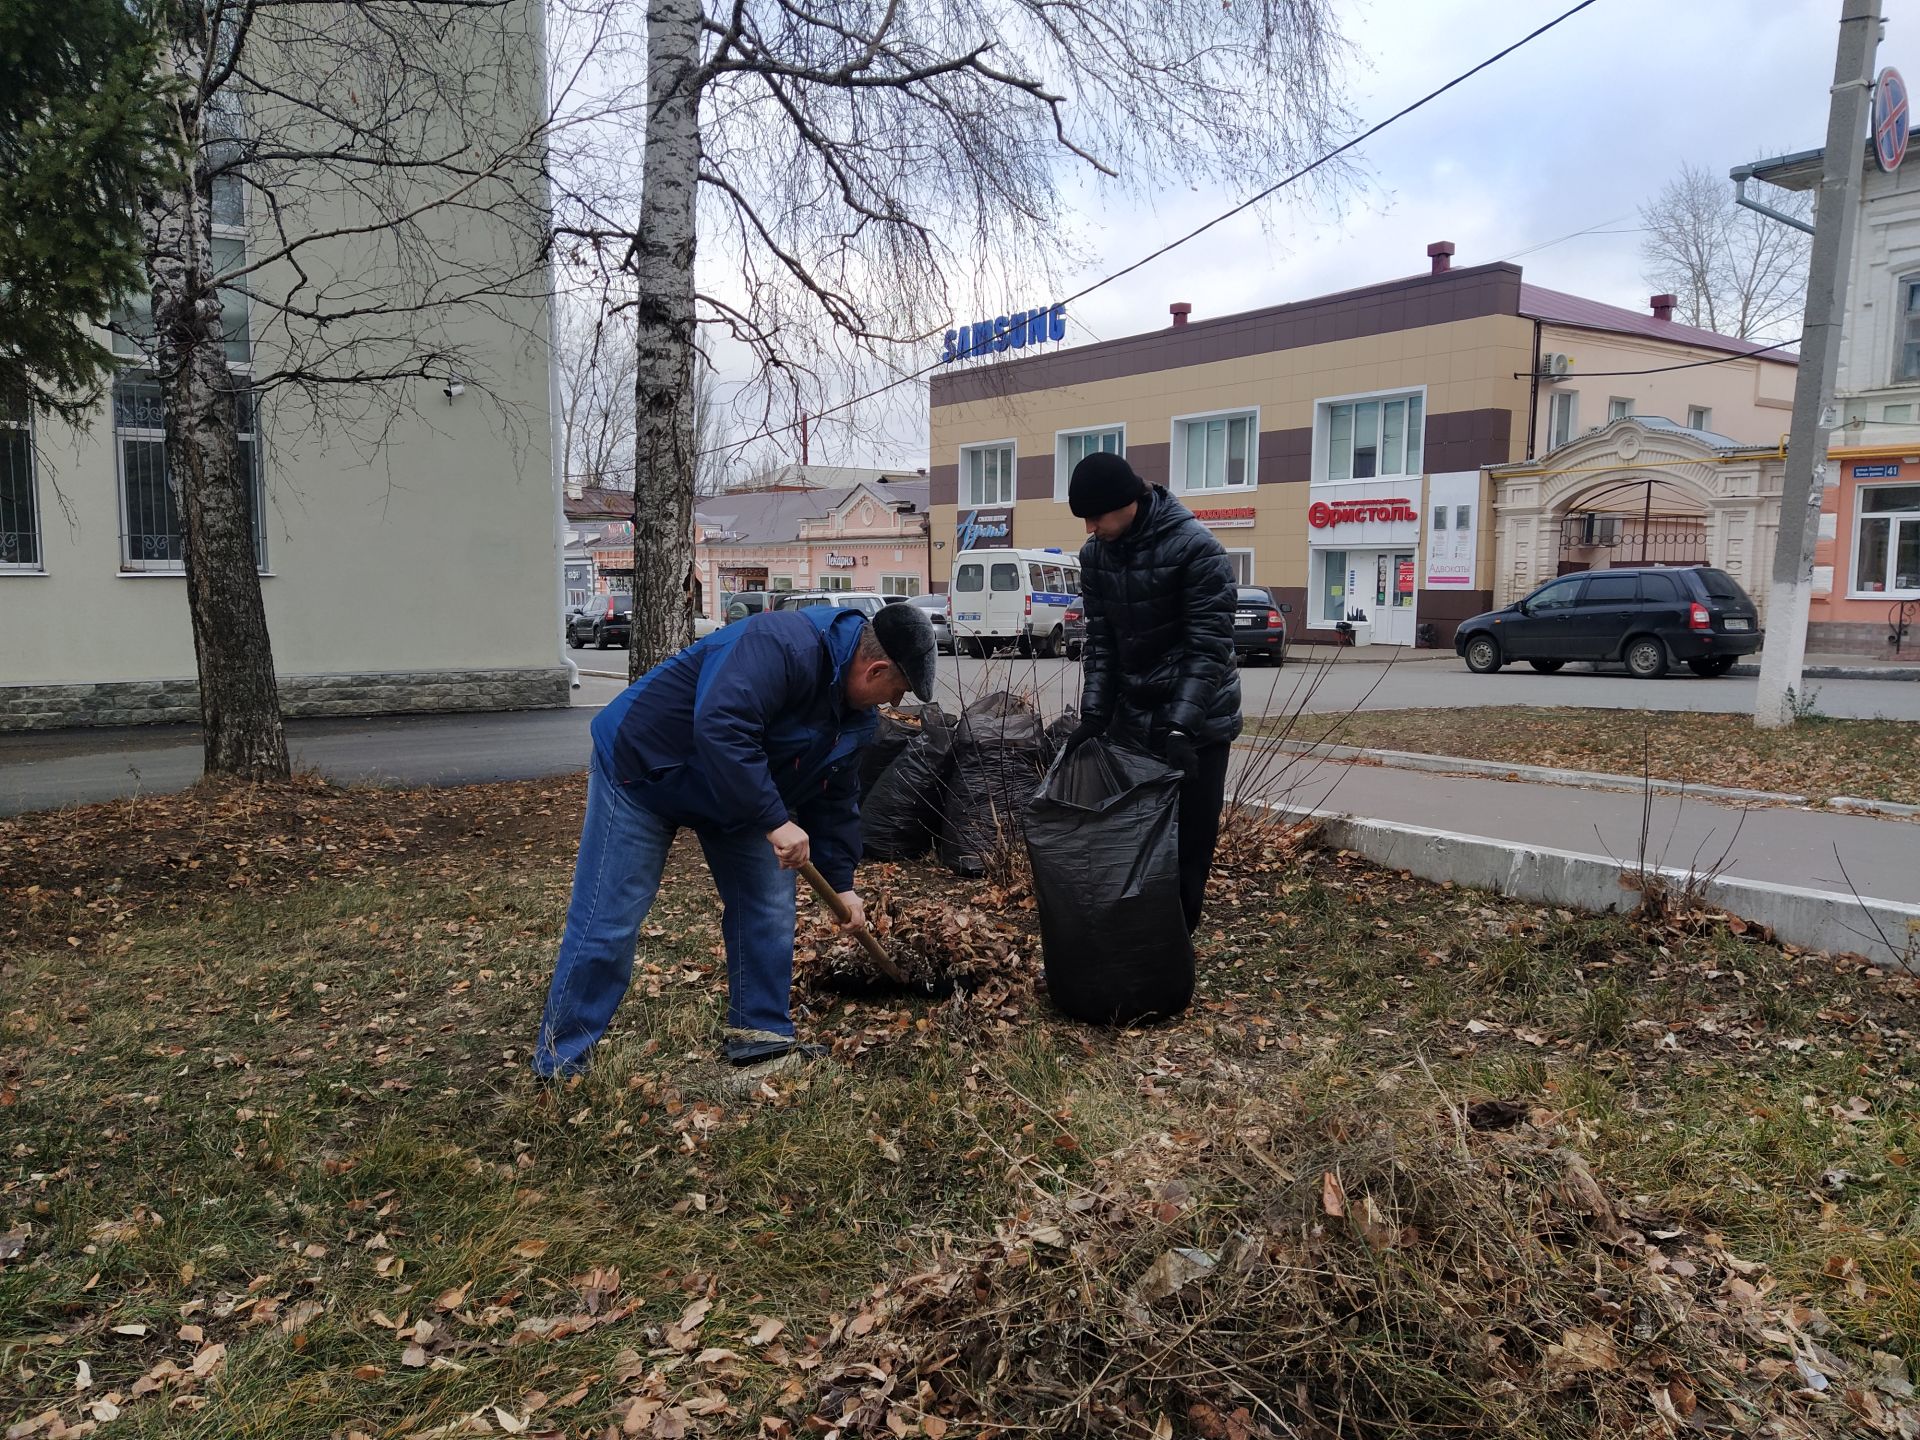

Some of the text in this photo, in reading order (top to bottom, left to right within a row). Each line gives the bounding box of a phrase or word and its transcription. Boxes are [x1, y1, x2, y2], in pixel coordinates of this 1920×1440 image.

[942, 303, 1066, 363] SAMSUNG
[1887, 466, 1898, 476] 41
[1191, 506, 1256, 519] РАХОВАНИЕ
[826, 553, 855, 569] Пекарня
[1430, 563, 1471, 575] Адвокаты
